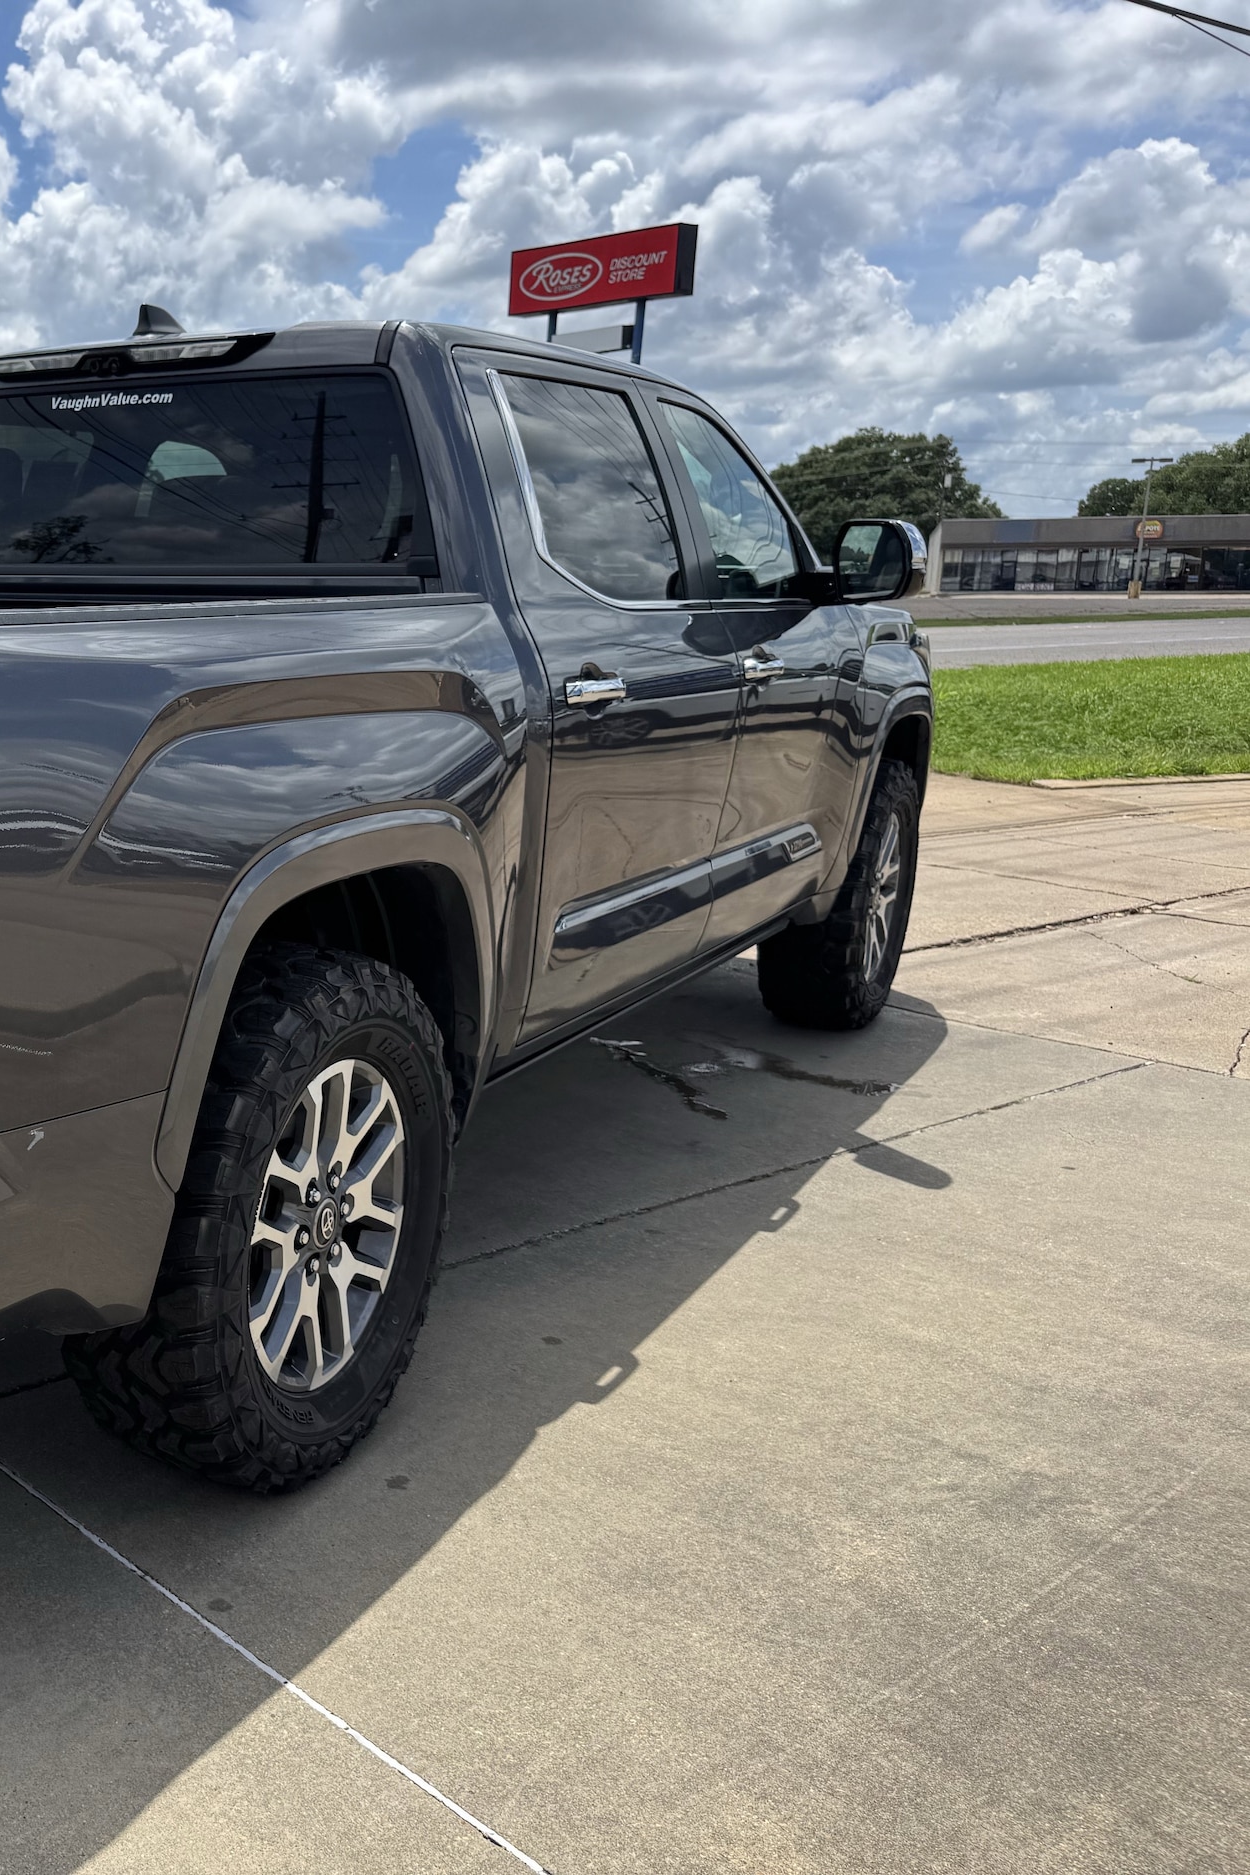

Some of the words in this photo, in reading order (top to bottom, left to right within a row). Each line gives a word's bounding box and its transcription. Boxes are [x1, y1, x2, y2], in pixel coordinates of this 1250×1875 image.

[609, 251, 668, 271] DISCOUNT
[529, 262, 593, 293] ROSES
[608, 267, 646, 284] STORE
[51, 392, 174, 412] VaughnValue.com
